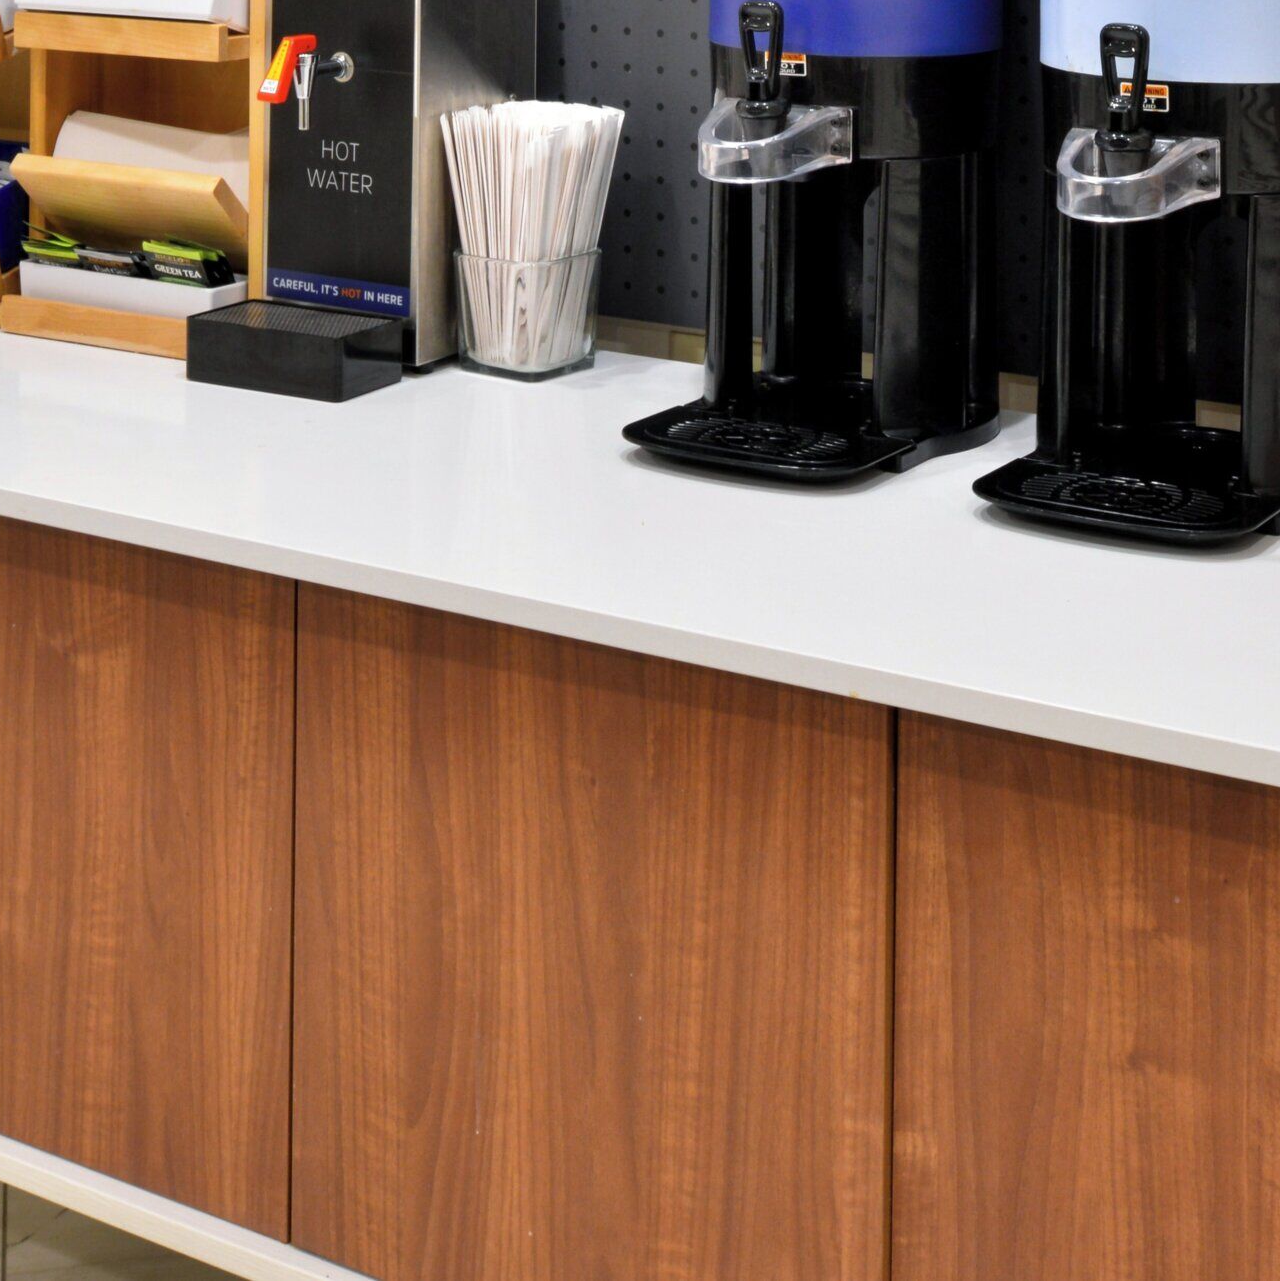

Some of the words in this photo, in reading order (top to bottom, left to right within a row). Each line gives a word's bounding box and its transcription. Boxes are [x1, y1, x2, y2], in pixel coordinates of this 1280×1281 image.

[321, 139, 360, 163] HOT
[307, 167, 373, 195] WATER
[154, 263, 183, 277] GREEN
[182, 269, 202, 279] TEA
[272, 277, 319, 295] CAREFUL,
[321, 284, 339, 296] IT'S
[341, 287, 362, 299] HOT
[364, 290, 375, 302] IN
[377, 292, 403, 306] HERE
